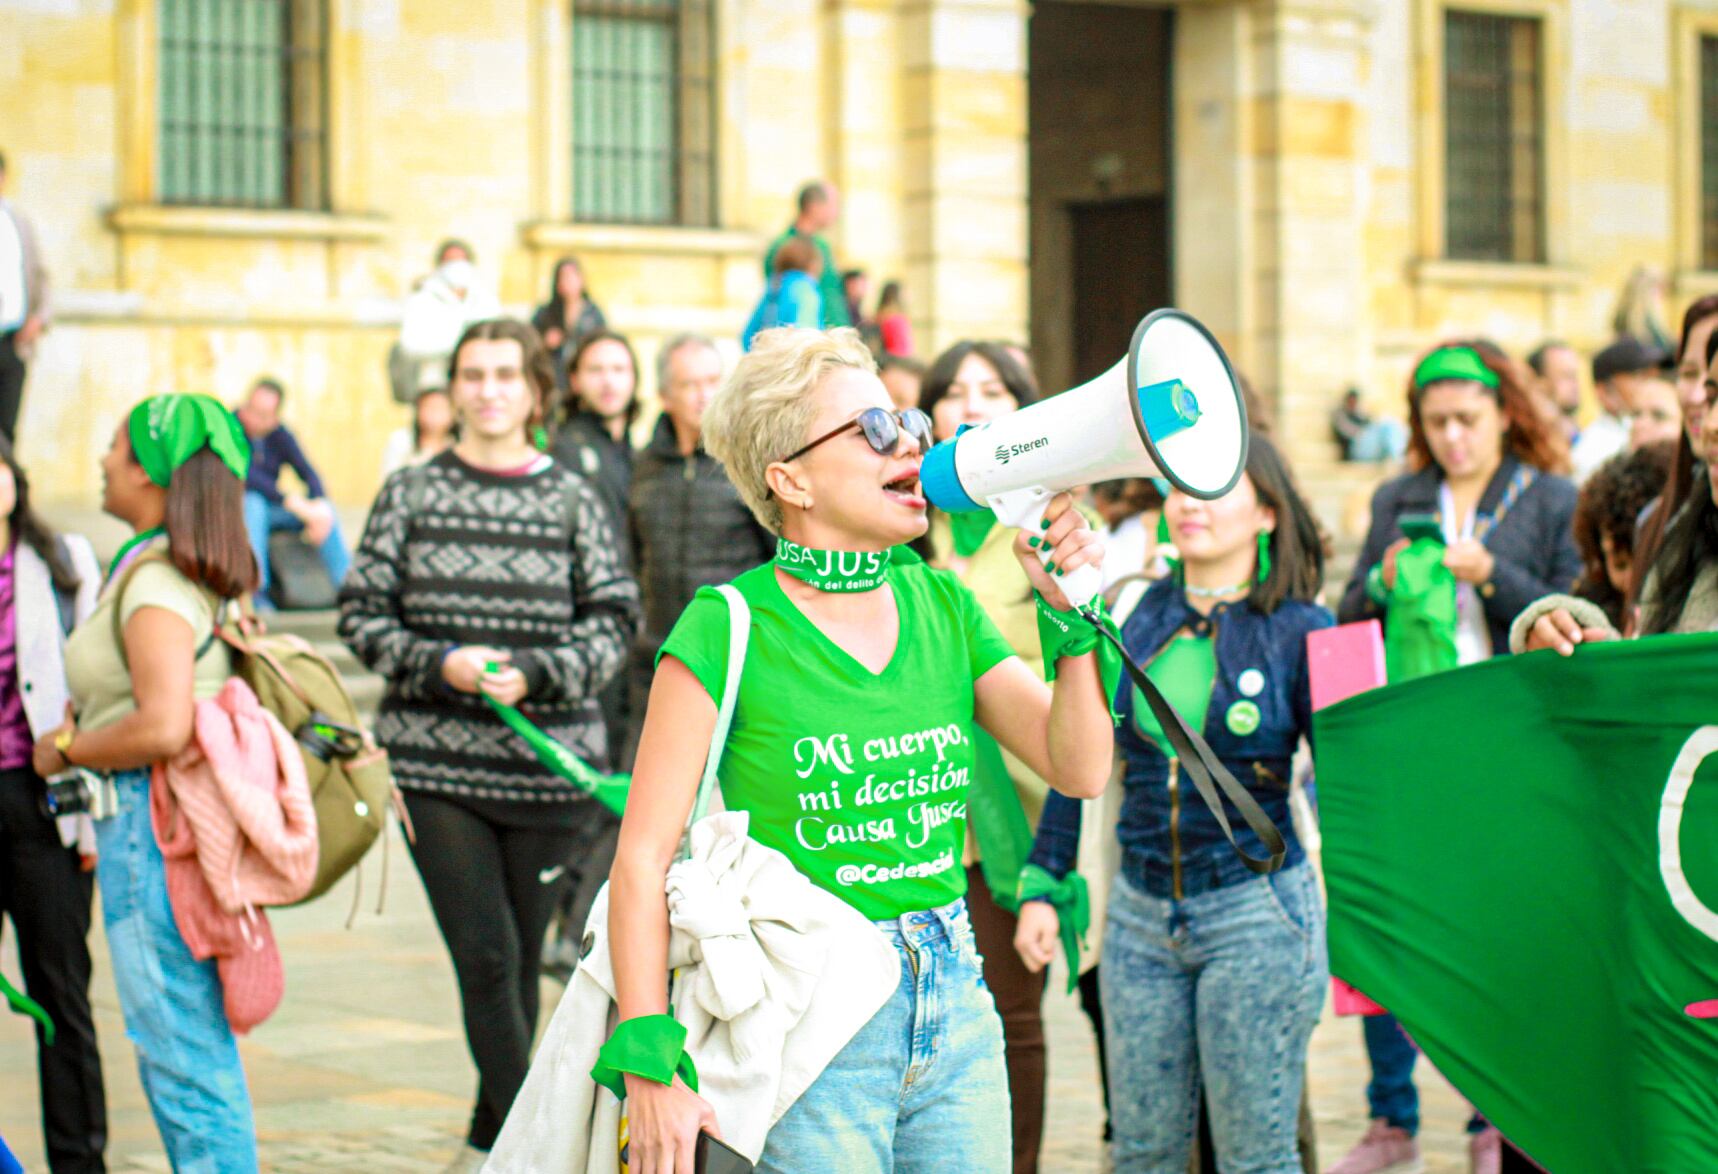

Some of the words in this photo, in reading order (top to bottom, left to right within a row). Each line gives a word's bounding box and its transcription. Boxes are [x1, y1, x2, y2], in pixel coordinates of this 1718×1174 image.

[1011, 437, 1049, 456] Steren
[825, 581, 842, 590] del
[846, 579, 874, 590] delito
[794, 734, 855, 778] Mi
[863, 724, 969, 763] cuerpo,
[798, 780, 842, 811] mi
[855, 762, 970, 806] decisión
[795, 816, 896, 850] Causa
